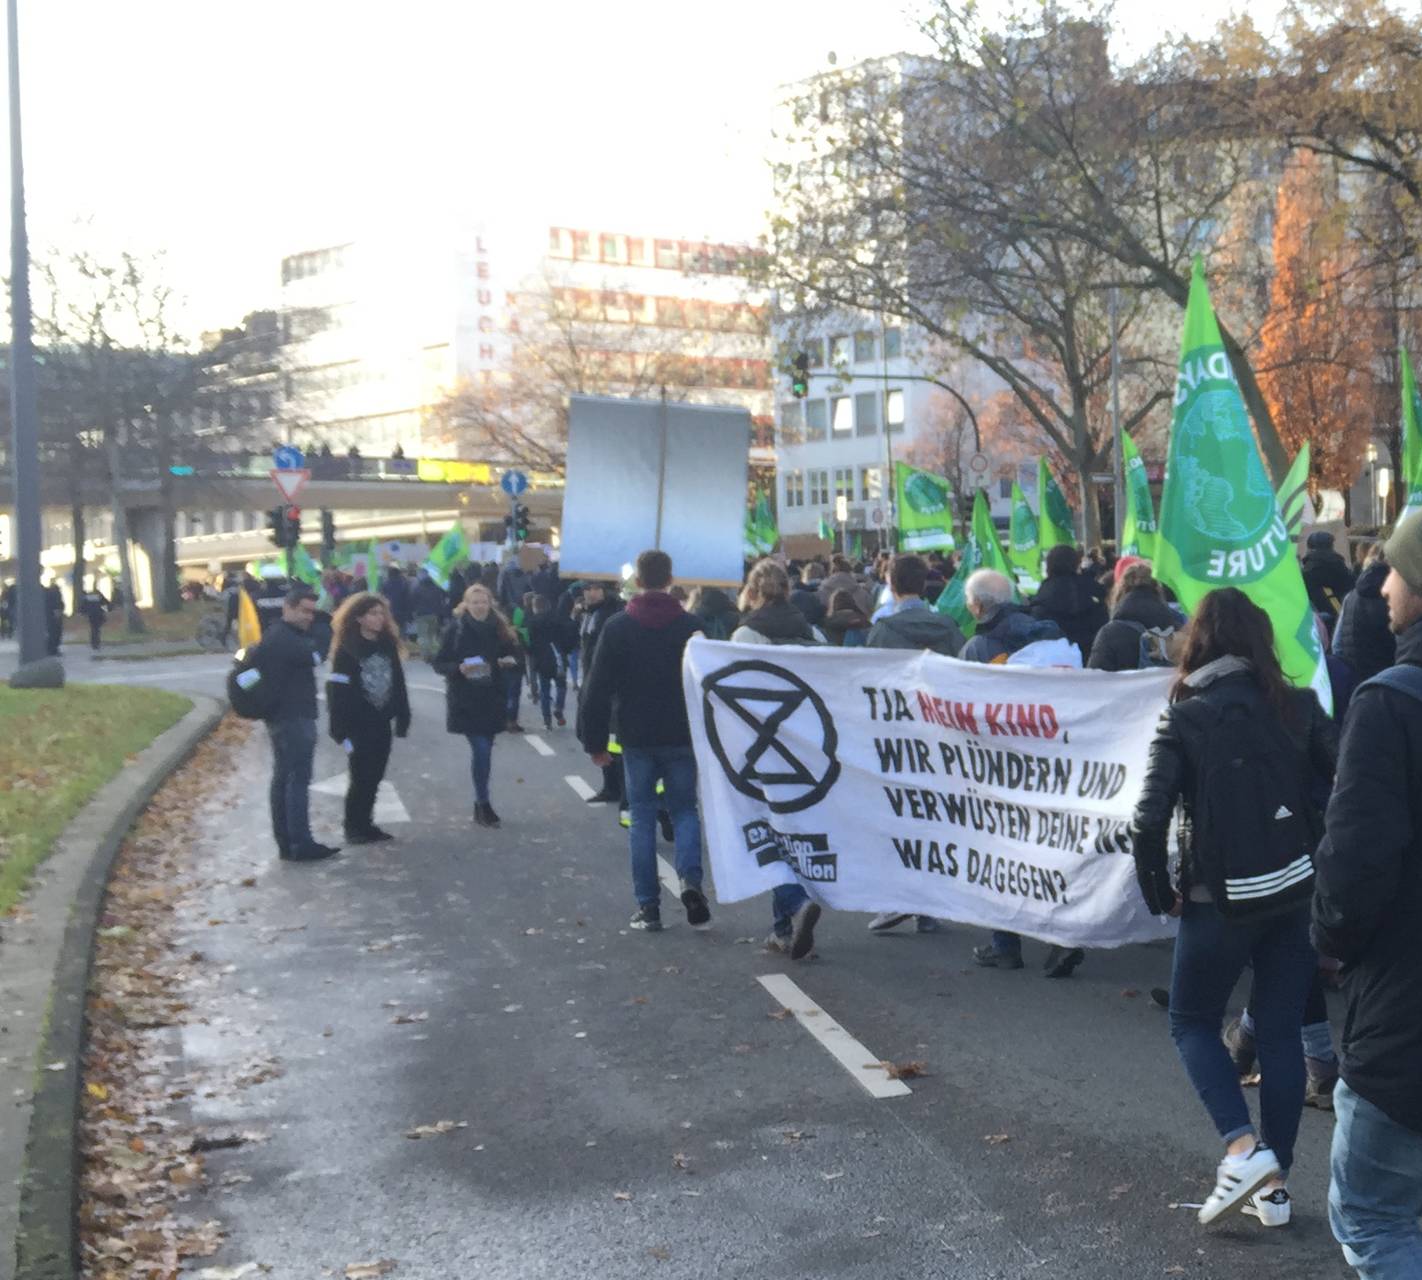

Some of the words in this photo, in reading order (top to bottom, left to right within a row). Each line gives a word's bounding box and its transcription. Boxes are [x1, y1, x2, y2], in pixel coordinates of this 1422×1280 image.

[862, 686, 914, 721] TJA
[916, 690, 980, 737] MEIN
[874, 738, 935, 774] WIR
[939, 739, 1072, 795] PLÜNDERN
[1078, 760, 1127, 800] UND
[883, 786, 1031, 842] VERWÜSTEN
[1037, 810, 1090, 854] DEINE
[891, 837, 959, 878] WAS
[967, 848, 1069, 905] DAGEGEN?
